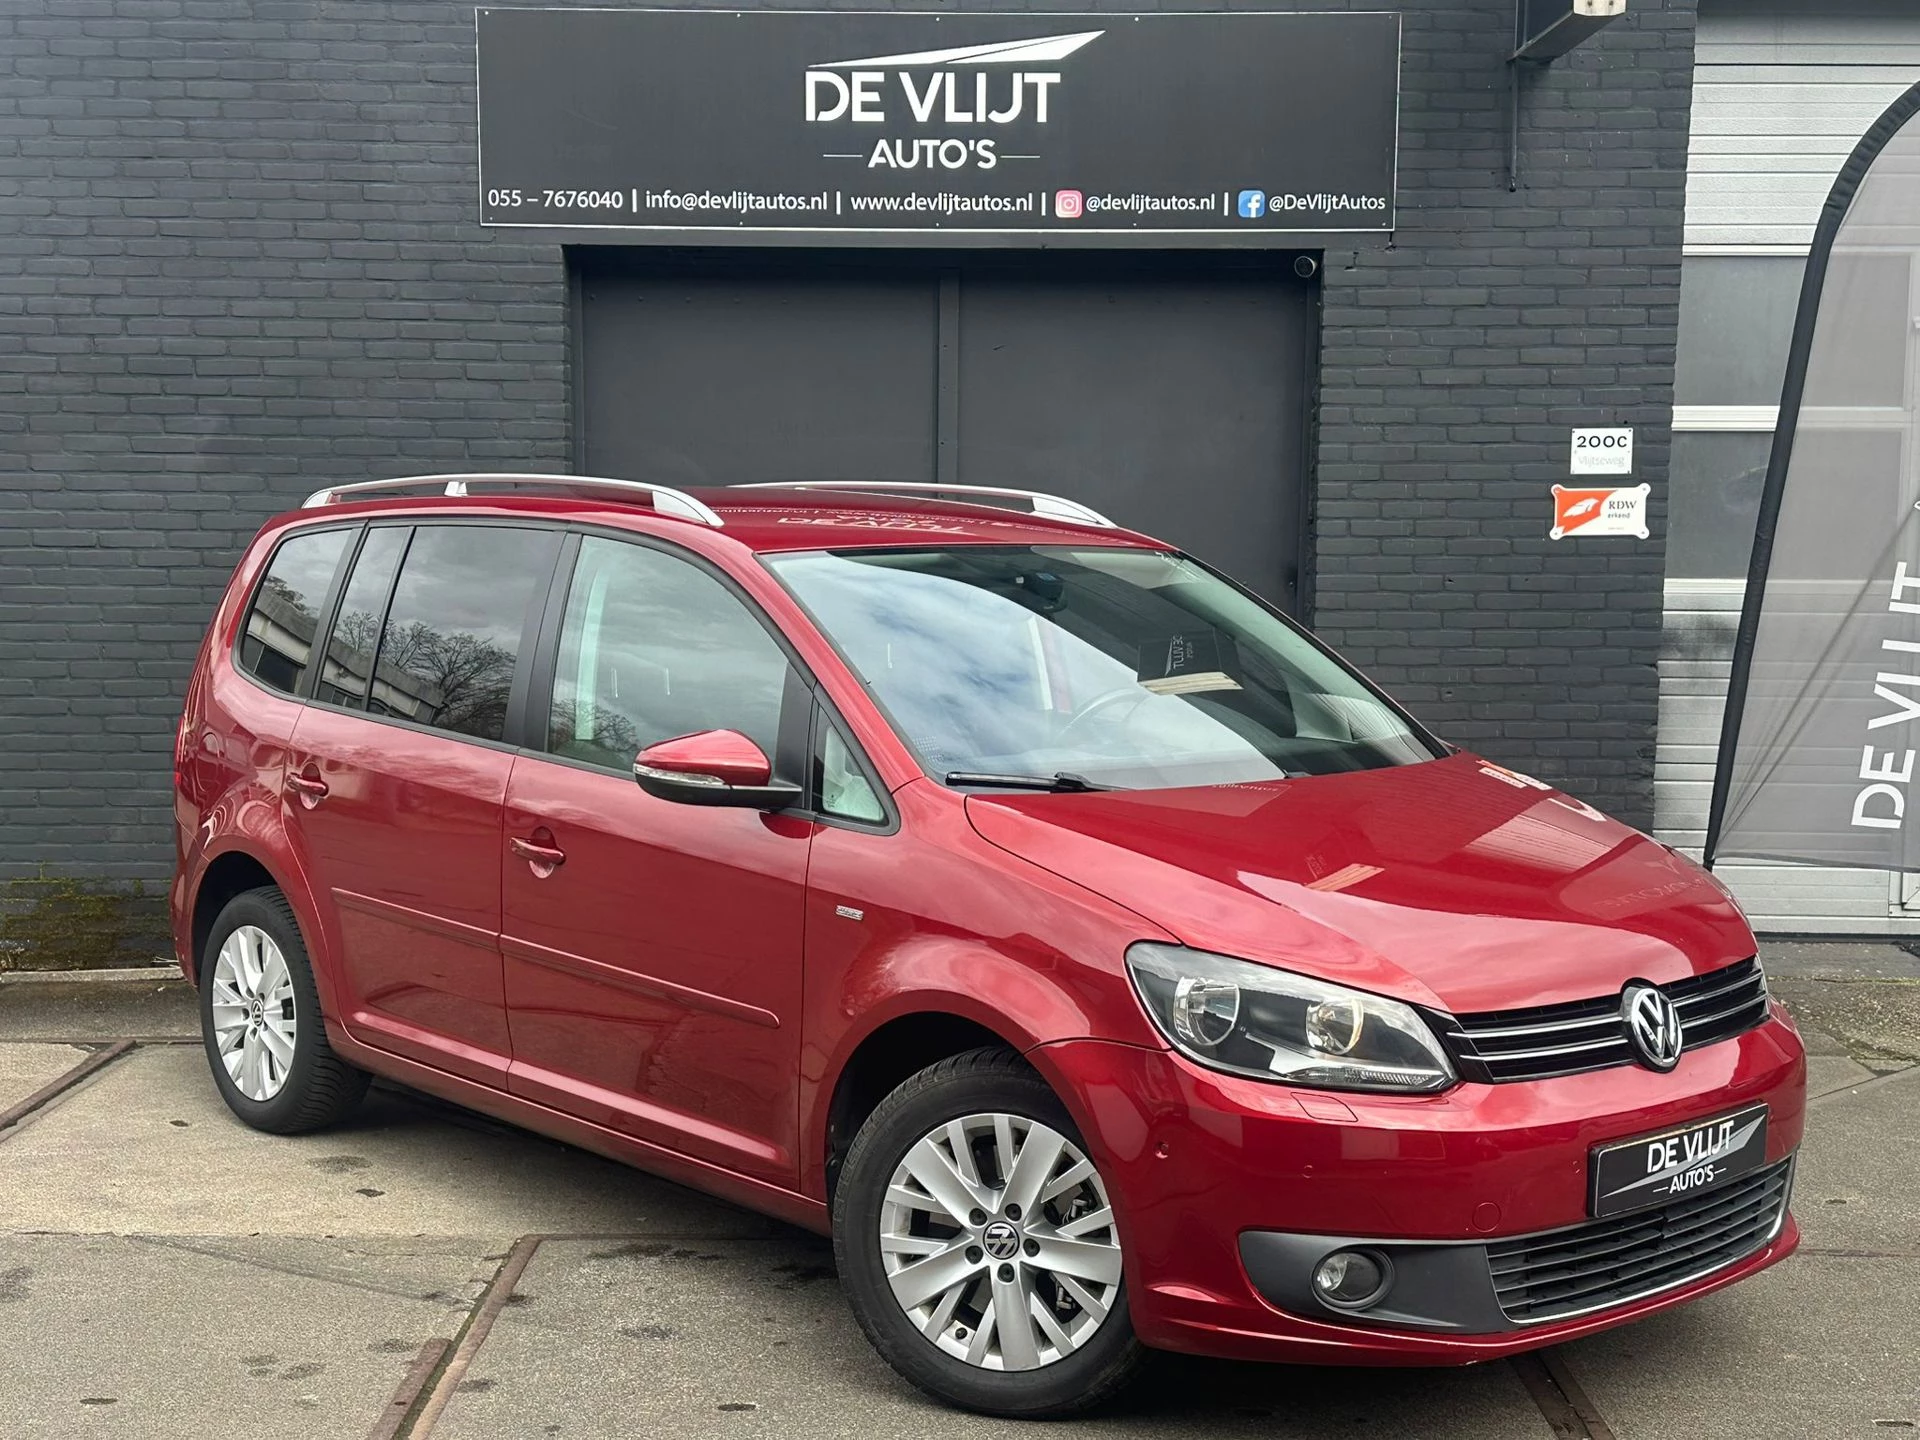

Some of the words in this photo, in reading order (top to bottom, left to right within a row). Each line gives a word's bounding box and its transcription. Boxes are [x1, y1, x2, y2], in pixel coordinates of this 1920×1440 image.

[805, 71, 885, 122] DE
[899, 71, 1061, 124] VLIJT
[868, 138, 997, 169] AUTO'S
[488, 190, 522, 207] 055
[543, 190, 624, 209] 7676040
[645, 190, 828, 214] info@devlijtautos.nl
[850, 191, 1033, 216] www.devlijtautos.nl
[1086, 193, 1216, 215] @devlijtautos.nl
[1268, 194, 1386, 215] @DeVlijtAutos
[1608, 500, 1637, 510] RDW
[1851, 744, 1916, 829] DE
[1647, 1137, 1680, 1173] DE
[1683, 1119, 1735, 1163] VLIJT
[1669, 1164, 1714, 1194] AUTO'S
